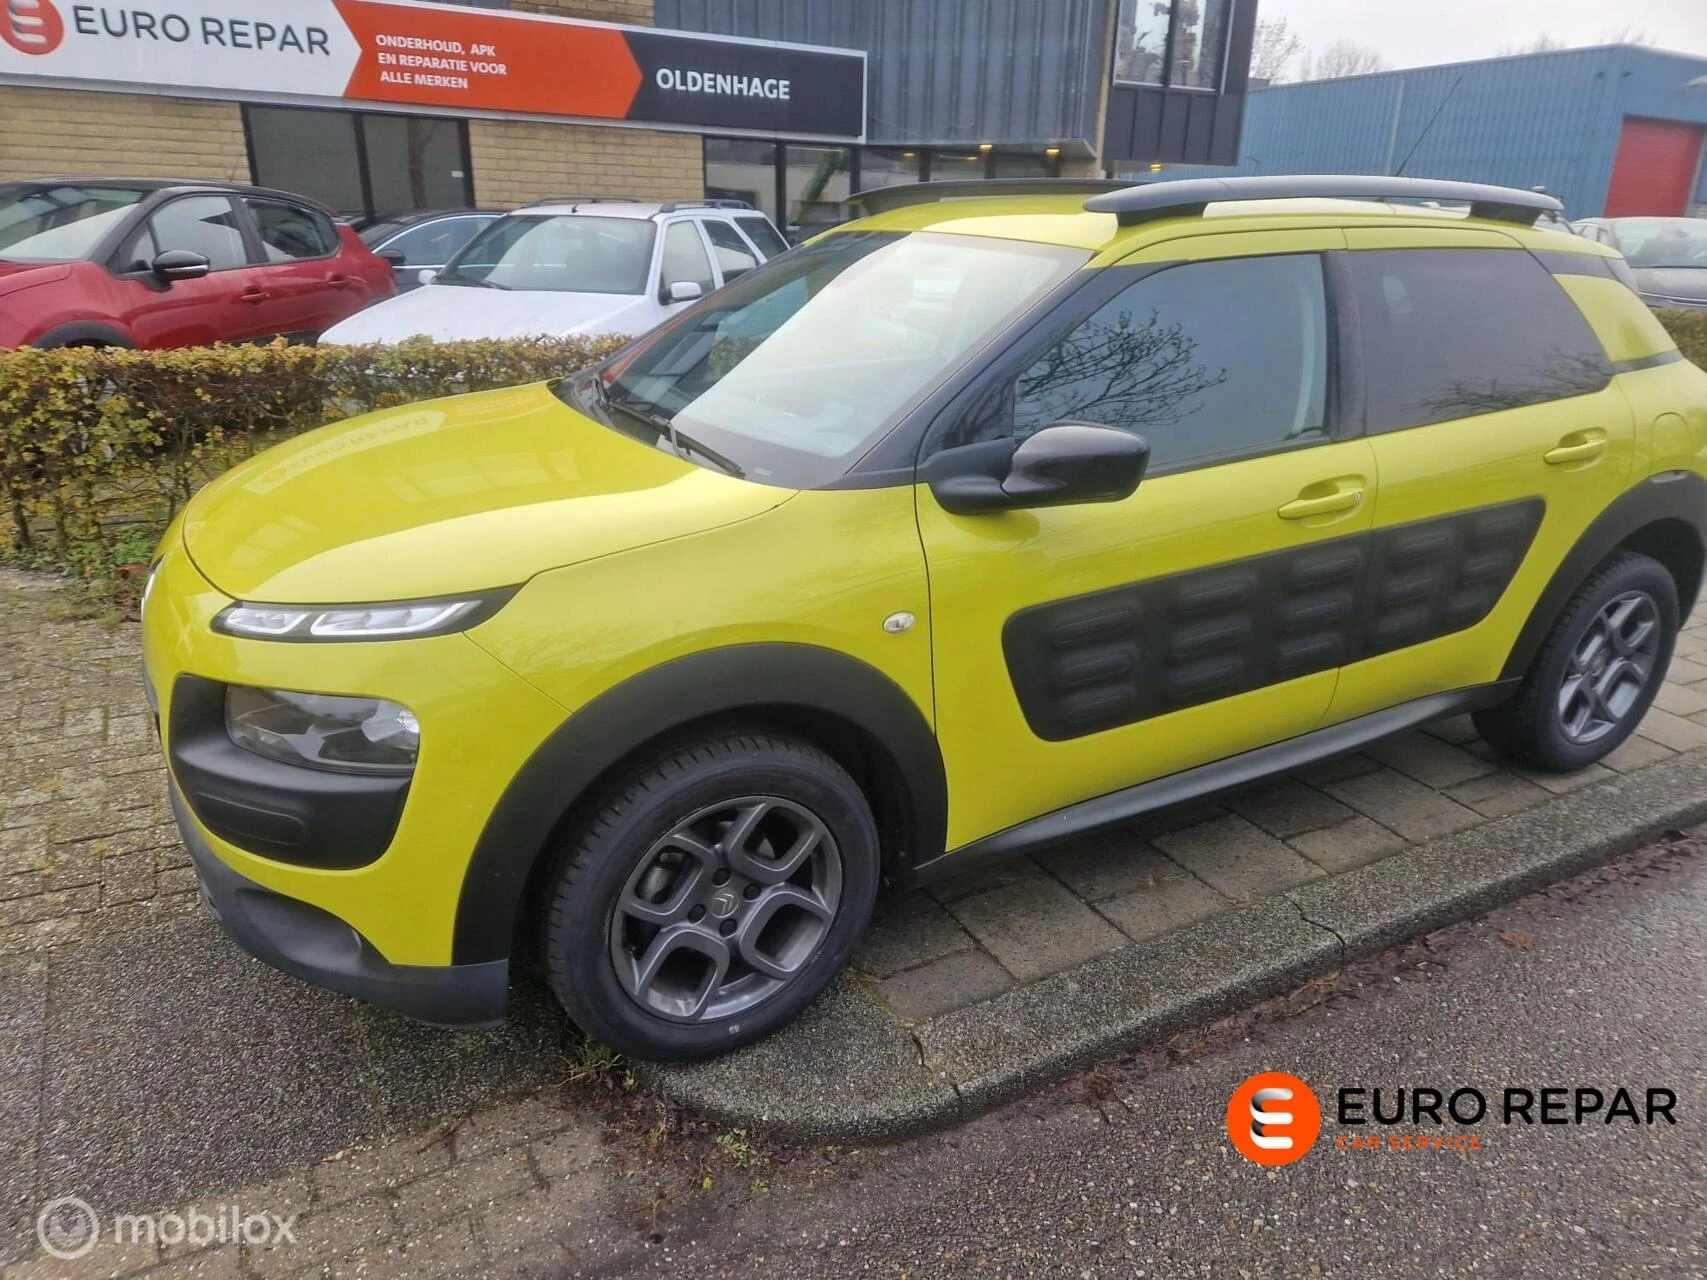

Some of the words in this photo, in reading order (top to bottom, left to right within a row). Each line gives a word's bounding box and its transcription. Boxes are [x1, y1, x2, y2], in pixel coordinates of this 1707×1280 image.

[73, 5, 190, 43] EURO
[200, 16, 331, 56] REPAR
[375, 34, 466, 55] ONDERHOUD,
[470, 44, 497, 57] APK
[378, 53, 397, 65] EN
[398, 54, 469, 72] REPARATIE
[469, 61, 507, 75] VOOR
[380, 71, 413, 84] ALLE
[414, 74, 469, 89] MERKEN
[655, 68, 791, 100] OLDENHAGE
